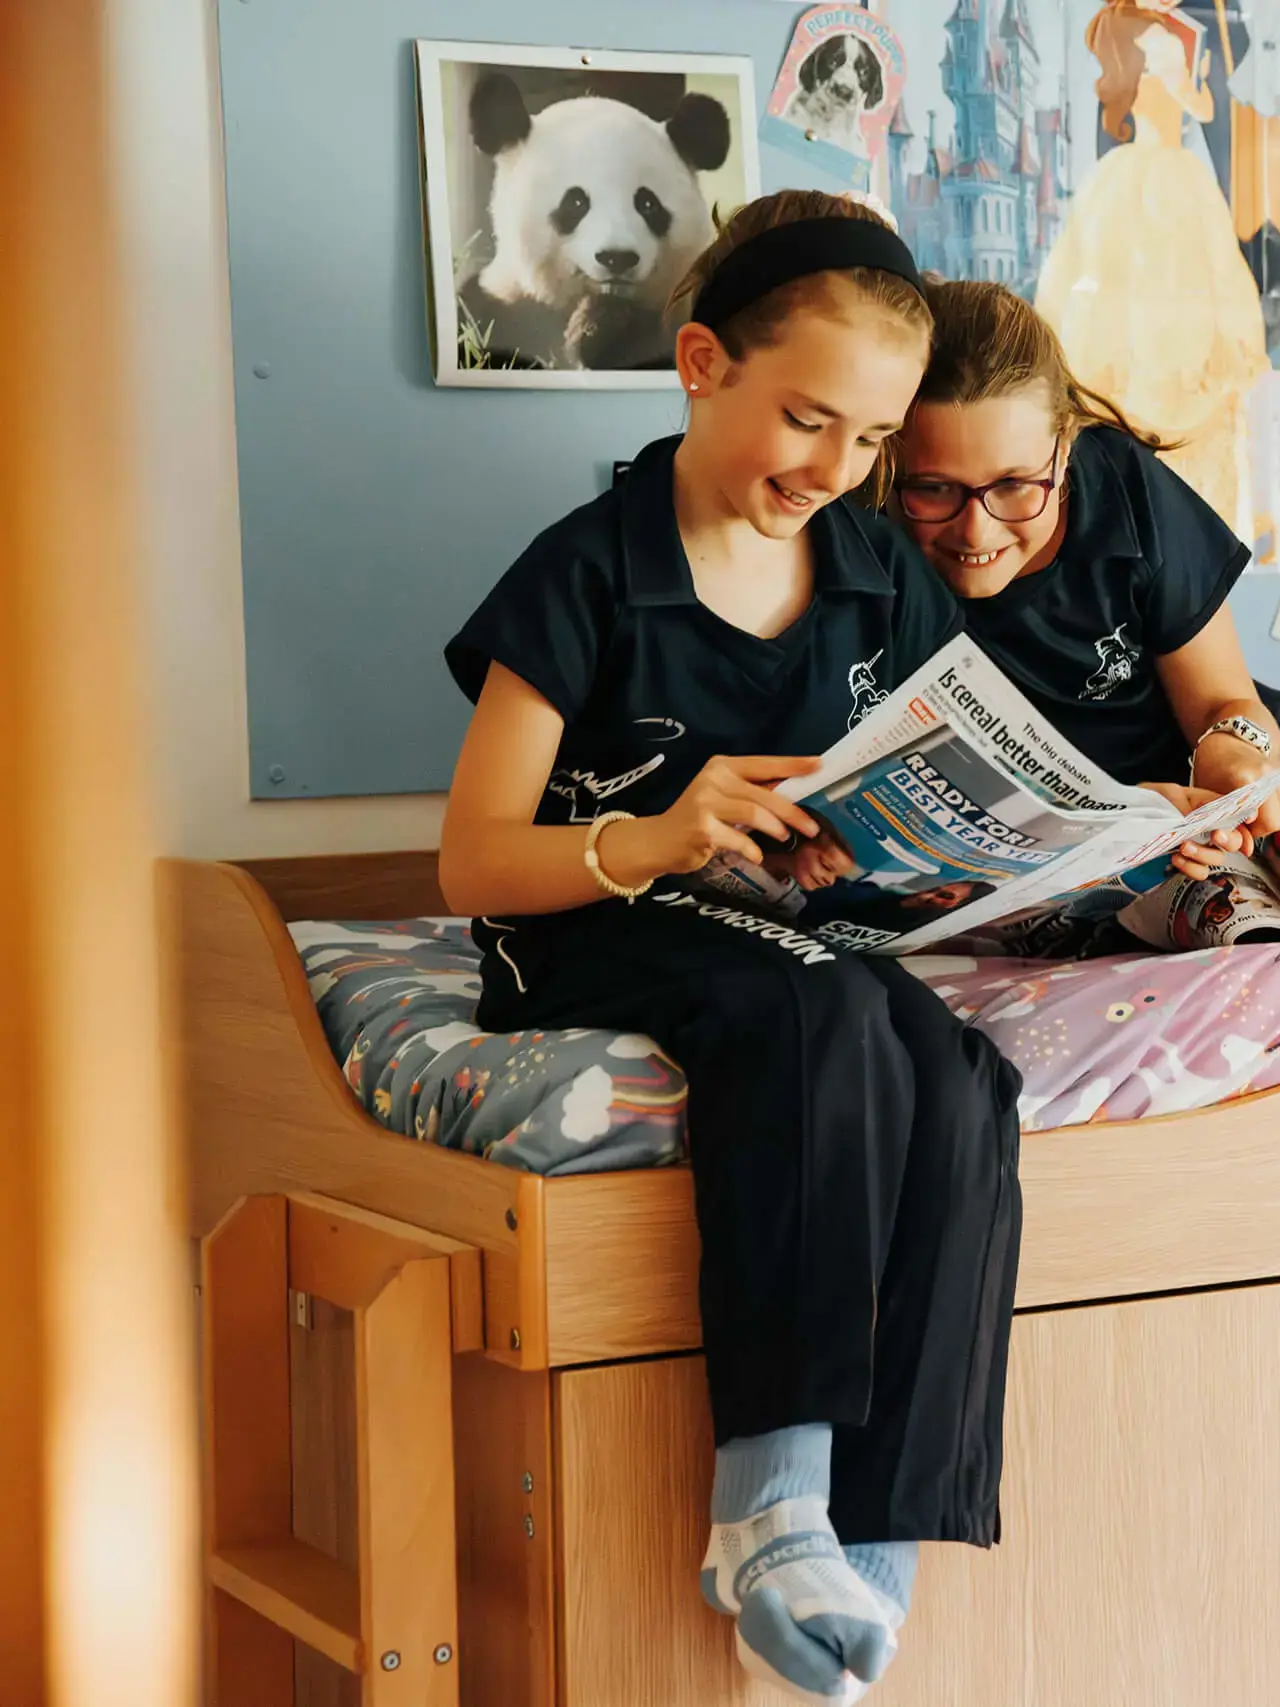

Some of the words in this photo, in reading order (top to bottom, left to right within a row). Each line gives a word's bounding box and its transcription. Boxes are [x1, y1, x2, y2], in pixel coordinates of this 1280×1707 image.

[805, 9, 872, 35] PERFECT
[938, 667, 957, 689] Is
[951, 683, 1000, 735] cereal
[992, 723, 1045, 777] better
[1040, 770, 1080, 801] than
[1022, 722, 1041, 744] The
[1040, 741, 1058, 760] big
[1057, 757, 1092, 786] debate
[893, 771, 945, 815] BEST
[946, 816, 1001, 852] YEAR
[905, 753, 981, 814] READY
[823, 922, 894, 942] SAVE
